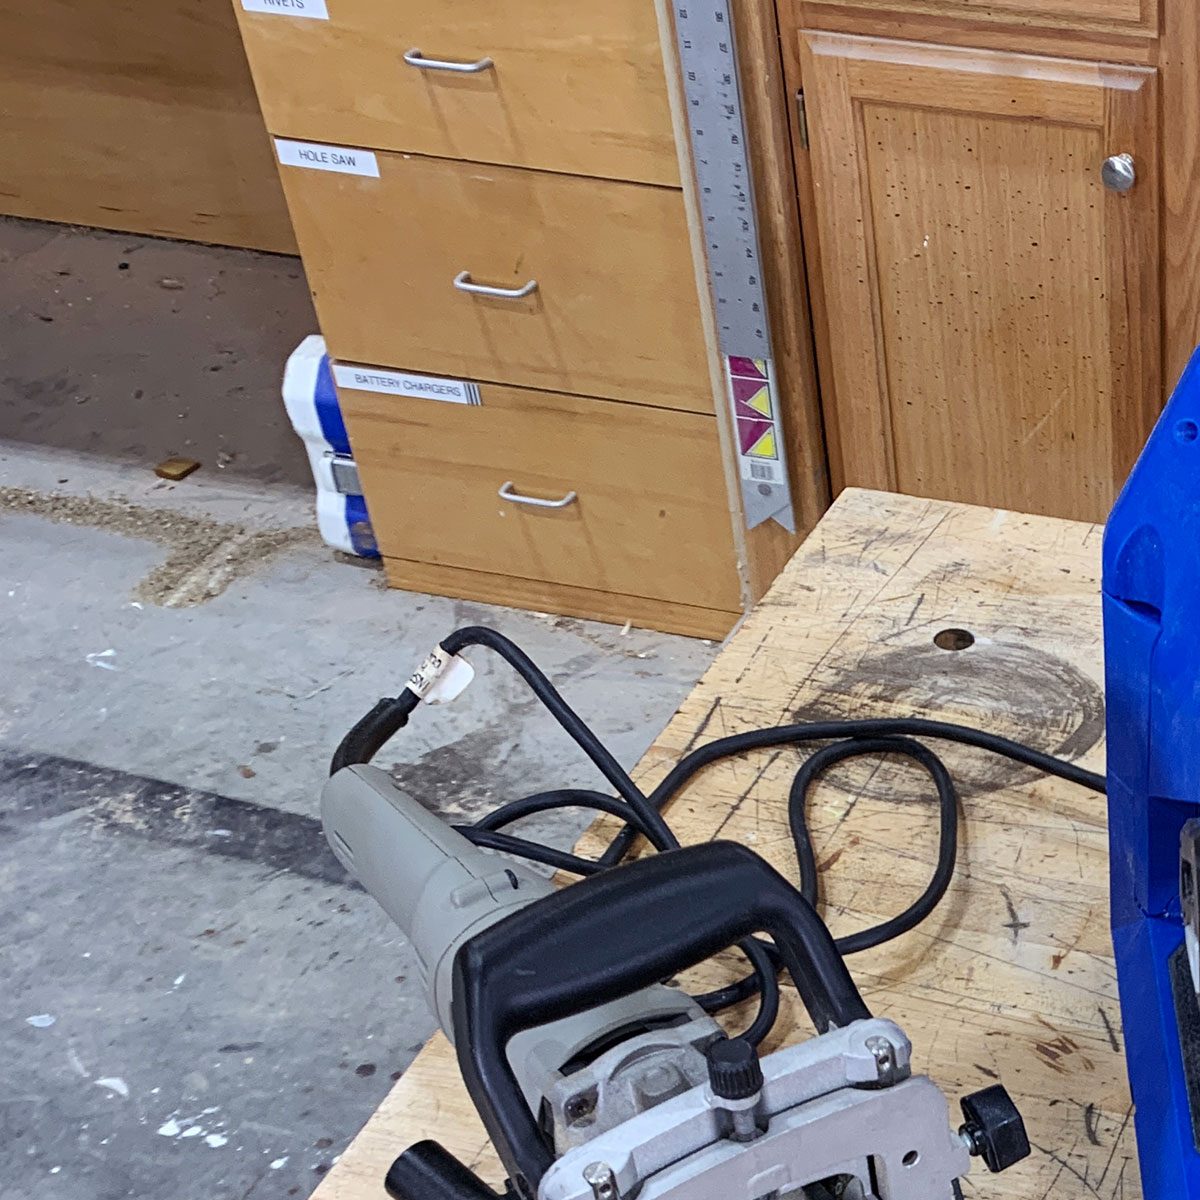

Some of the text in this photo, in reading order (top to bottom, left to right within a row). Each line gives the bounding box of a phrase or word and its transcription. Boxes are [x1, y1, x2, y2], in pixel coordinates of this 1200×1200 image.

[298, 149, 357, 167] HOLE SAW
[354, 373, 462, 397] BATTERY CHARGERS
